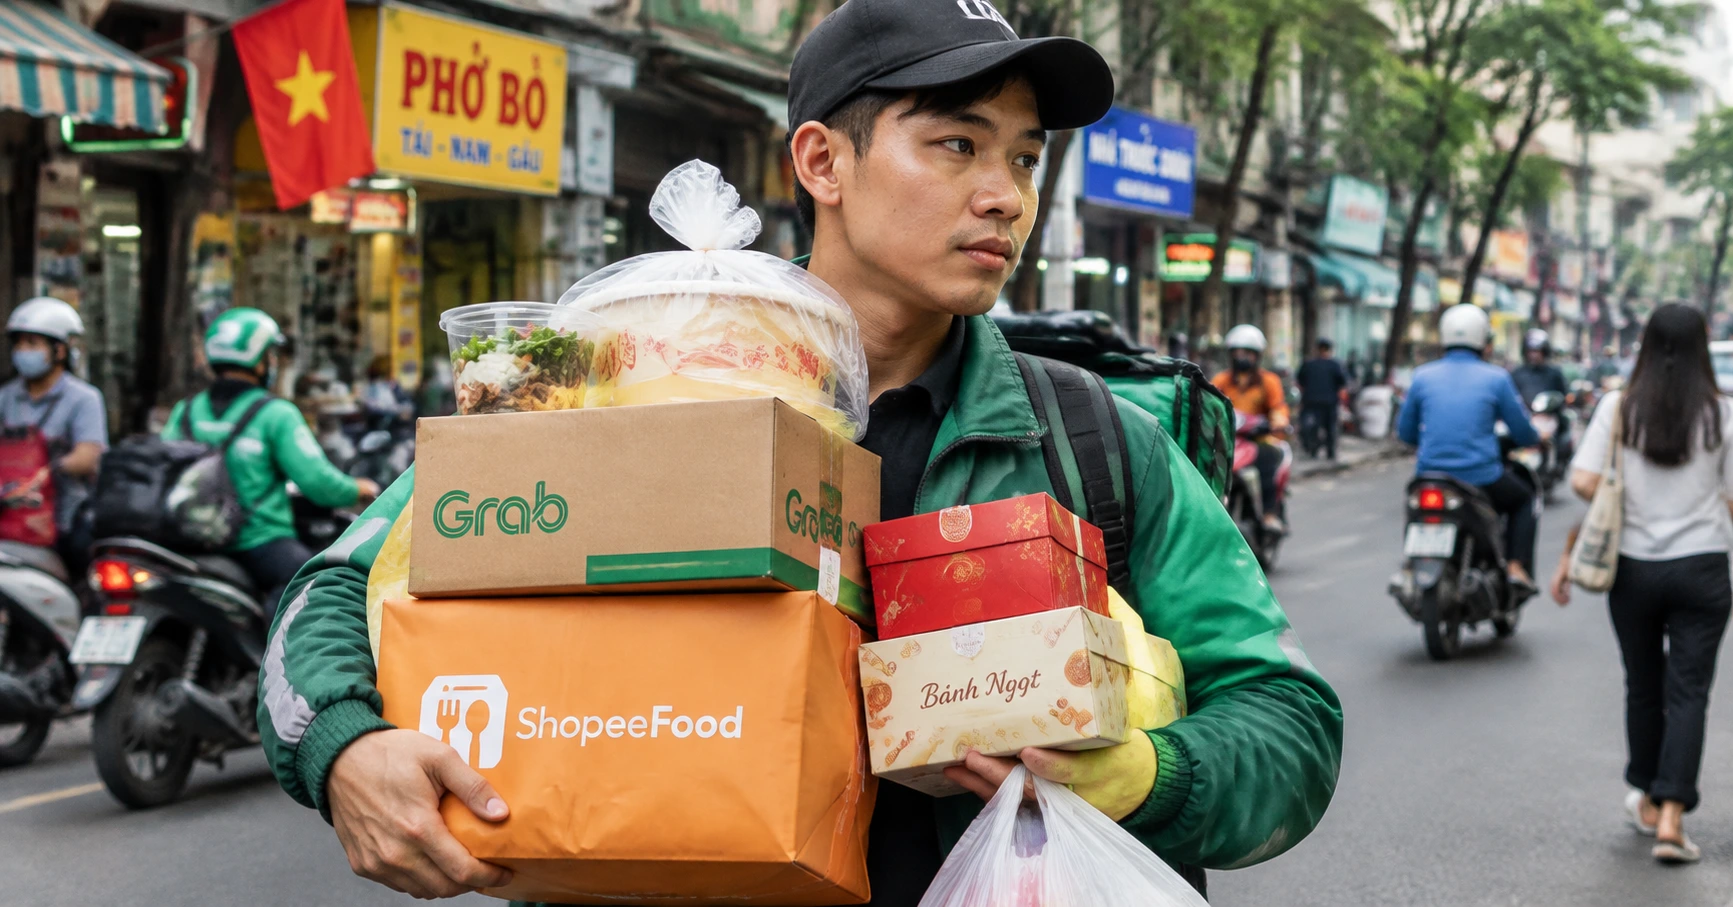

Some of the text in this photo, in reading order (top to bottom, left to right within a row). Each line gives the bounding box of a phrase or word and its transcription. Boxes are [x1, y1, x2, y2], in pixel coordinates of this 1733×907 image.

[402, 41, 489, 121] PHỞ
[433, 480, 569, 539] Grab
[516, 705, 743, 747] ShopeeFood
